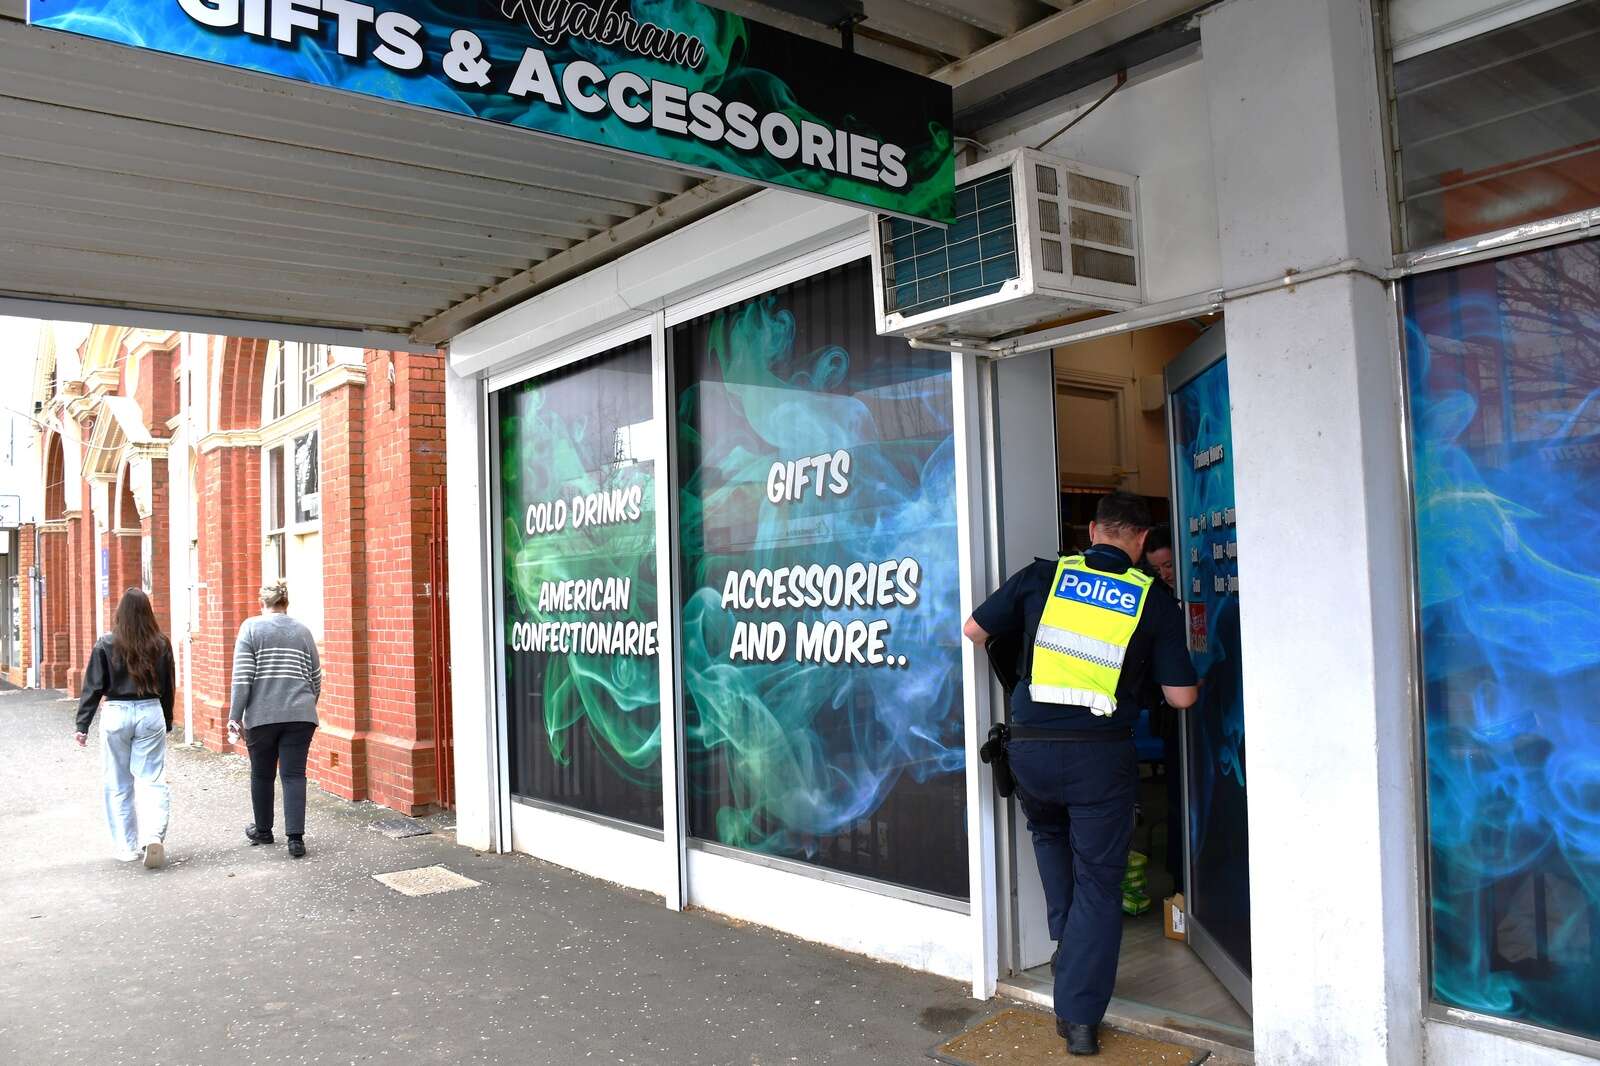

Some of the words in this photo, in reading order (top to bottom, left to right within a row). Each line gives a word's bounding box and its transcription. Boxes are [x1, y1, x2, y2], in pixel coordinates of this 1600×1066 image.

[442, 29, 492, 88] &
[507, 47, 909, 189] ACCESSORIES
[766, 449, 851, 504] GIFTS
[525, 497, 567, 536] COLD
[571, 484, 642, 527] DRINKS
[537, 576, 631, 613] AMERICAN
[720, 557, 920, 610] ACCESSORIES
[1059, 573, 1137, 610] Police
[511, 620, 660, 656] CONFECTIONARIE
[728, 620, 788, 662] AND
[794, 619, 908, 667] MORE..
